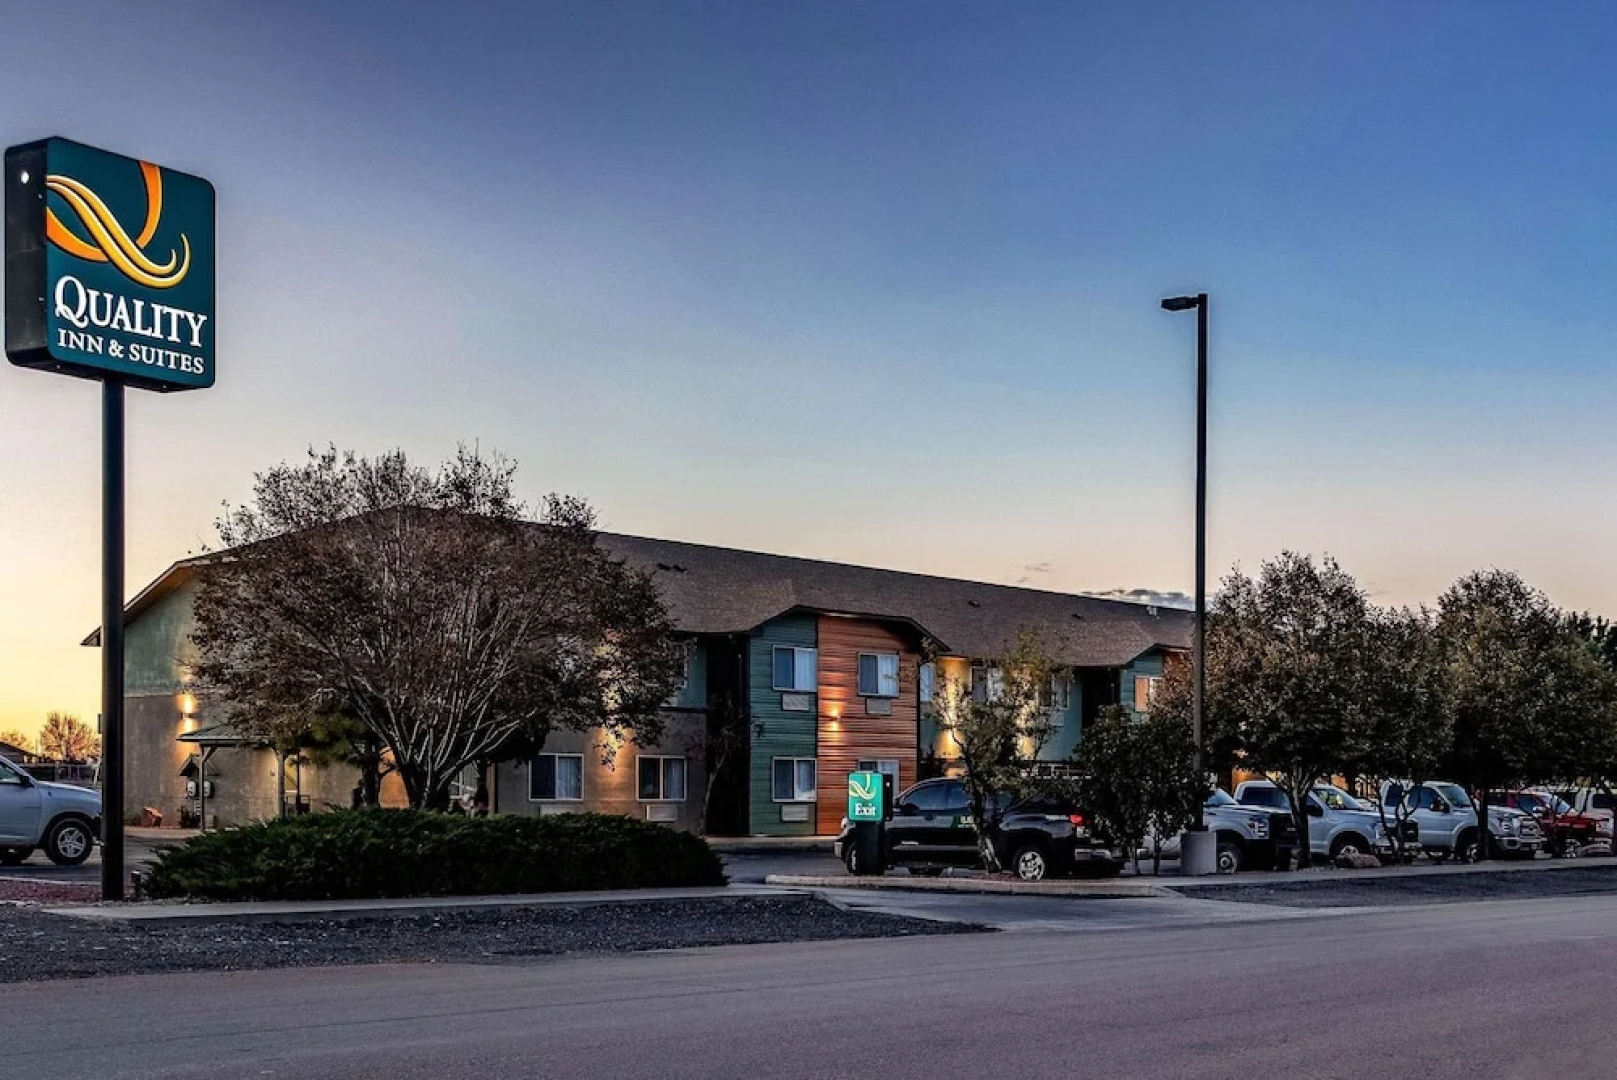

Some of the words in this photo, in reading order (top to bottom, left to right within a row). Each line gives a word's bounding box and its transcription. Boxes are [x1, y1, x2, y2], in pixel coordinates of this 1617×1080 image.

[54, 275, 207, 347] QUALITY
[58, 328, 104, 355] INN
[109, 339, 125, 358] &
[129, 343, 205, 374] SUITES
